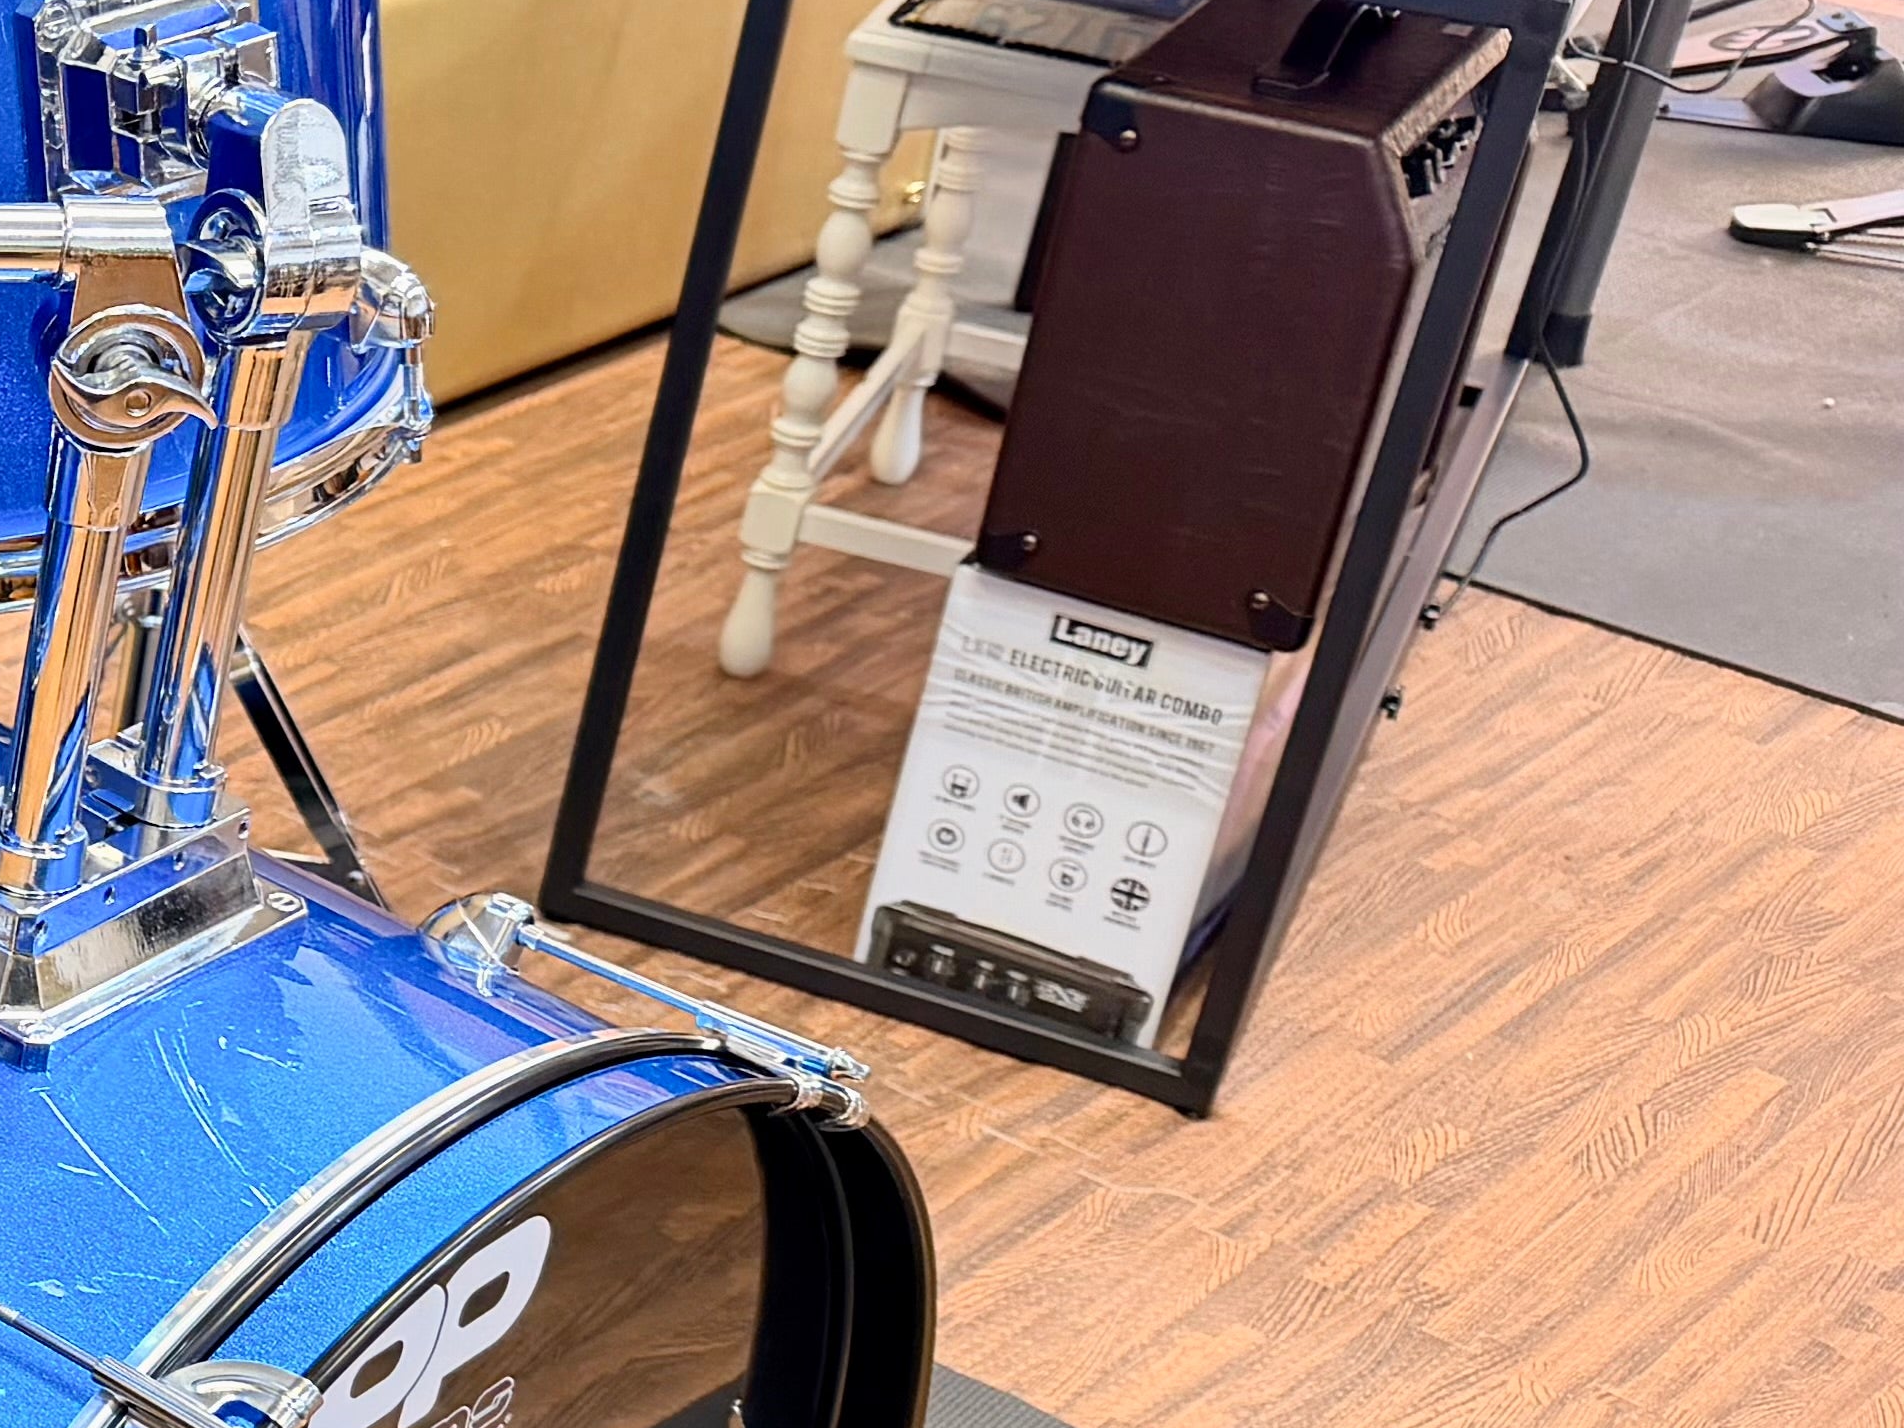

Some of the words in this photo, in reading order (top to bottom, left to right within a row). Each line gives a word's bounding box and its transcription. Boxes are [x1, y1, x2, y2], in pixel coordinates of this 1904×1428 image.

[1053, 616, 1150, 666] Laney
[1008, 649, 1092, 688] ELECTRIC
[1159, 693, 1224, 727] COMBO
